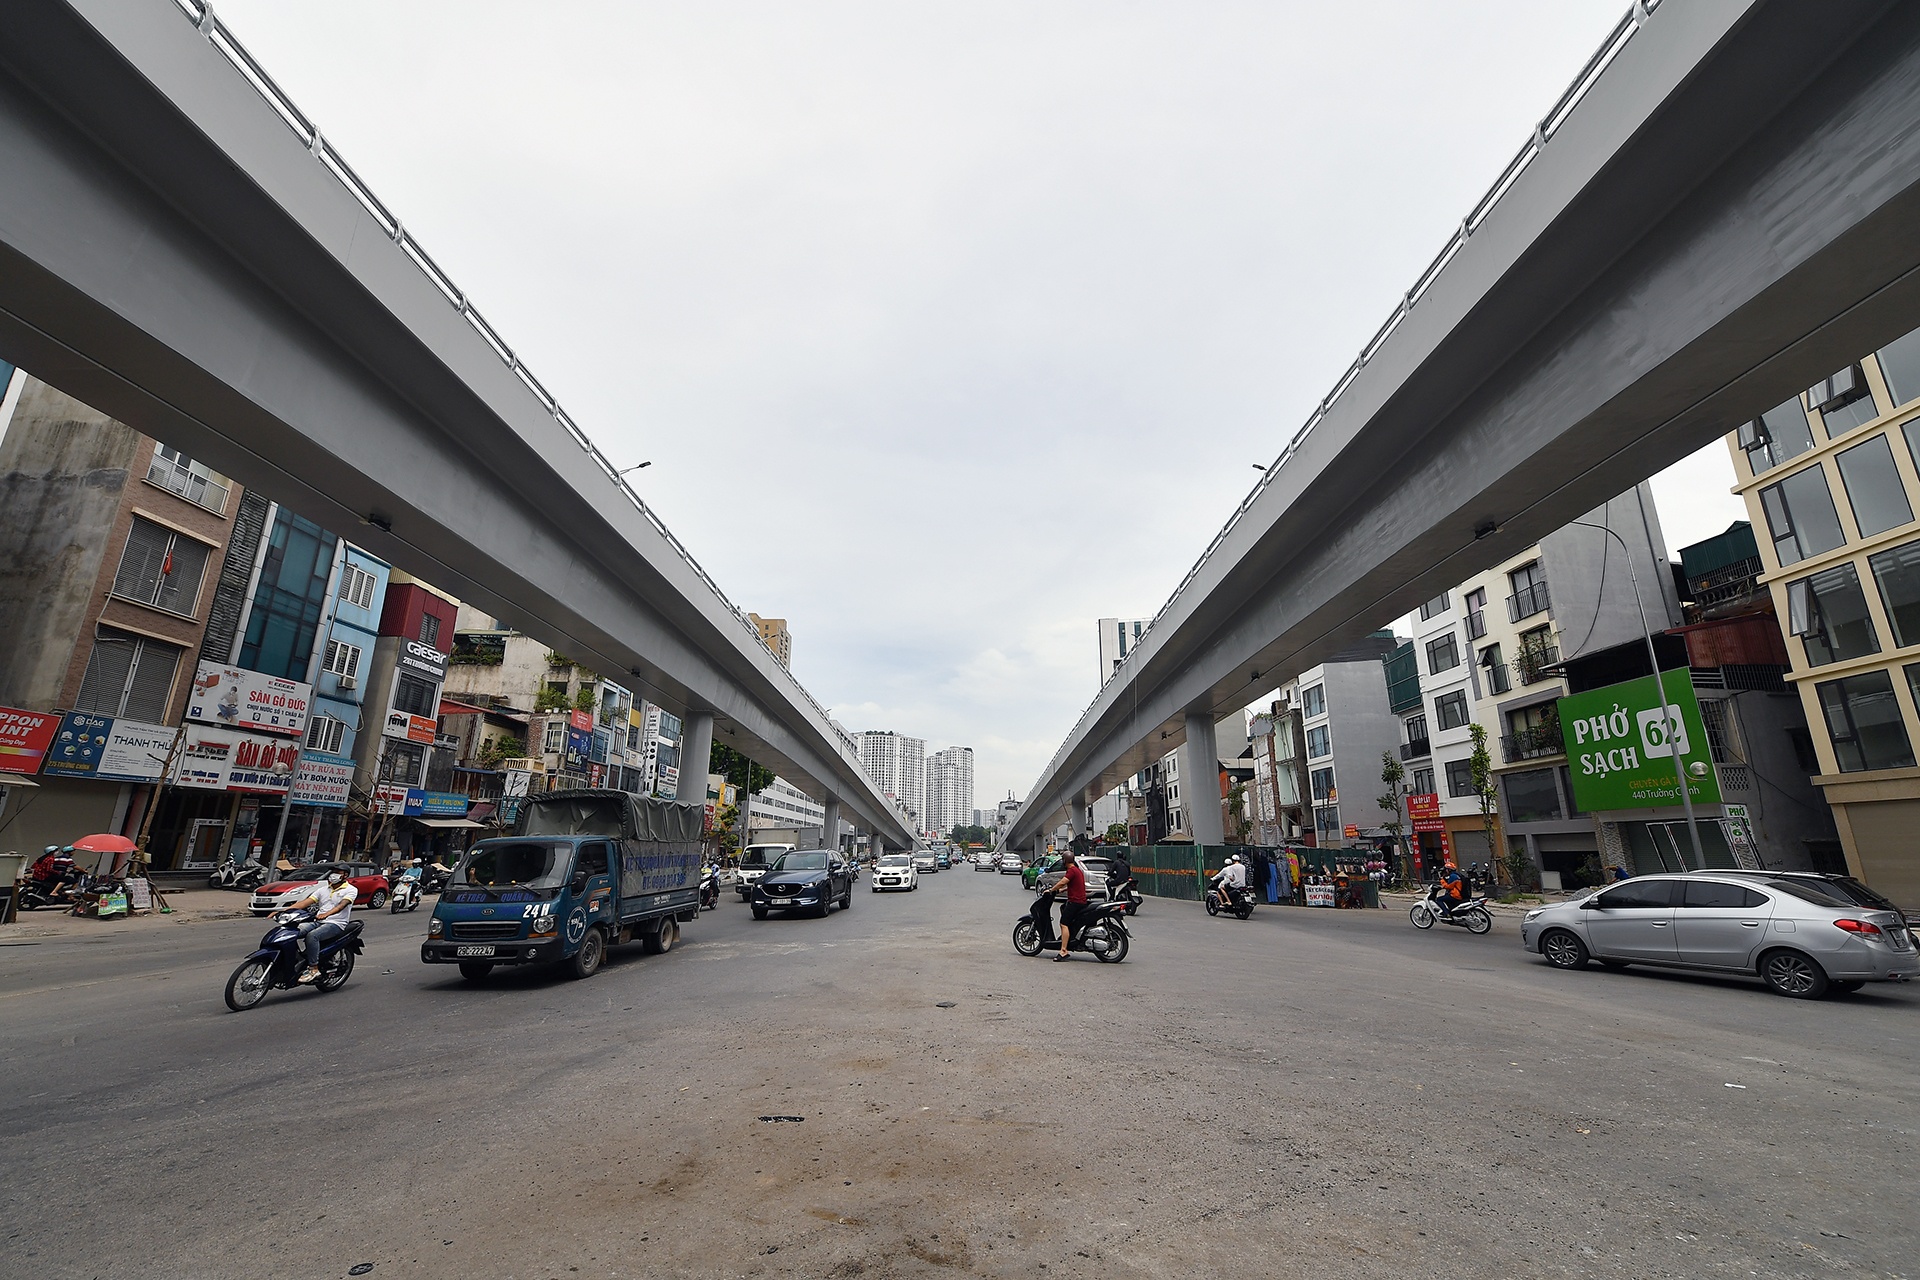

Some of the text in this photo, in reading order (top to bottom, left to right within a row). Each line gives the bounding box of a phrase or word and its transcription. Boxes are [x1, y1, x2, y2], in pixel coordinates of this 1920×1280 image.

[249, 689, 306, 711] SÀN GỖ ĐỨC
[85, 718, 105, 727] DAG
[1572, 703, 1682, 747] PHỞ 62
[114, 735, 173, 751] THANH THỦ
[235, 738, 261, 767] SÀN
[259, 739, 278, 769] GỖ
[317, 763, 335, 775] RỬA
[334, 768, 347, 776] XE
[1579, 746, 1640, 779] SẠCH
[297, 772, 349, 786] ÁY BƠM NƯỚC
[1629, 776, 1659, 789] CHUYÊN
[1660, 775, 1671, 786] GÀ
[1632, 785, 1700, 799] 440 Trường Cnh
[407, 797, 423, 808] INAX
[1728, 804, 1745, 816] PHỞ
[466, 893, 488, 902] TREO
[522, 902, 551, 918] 24 H
